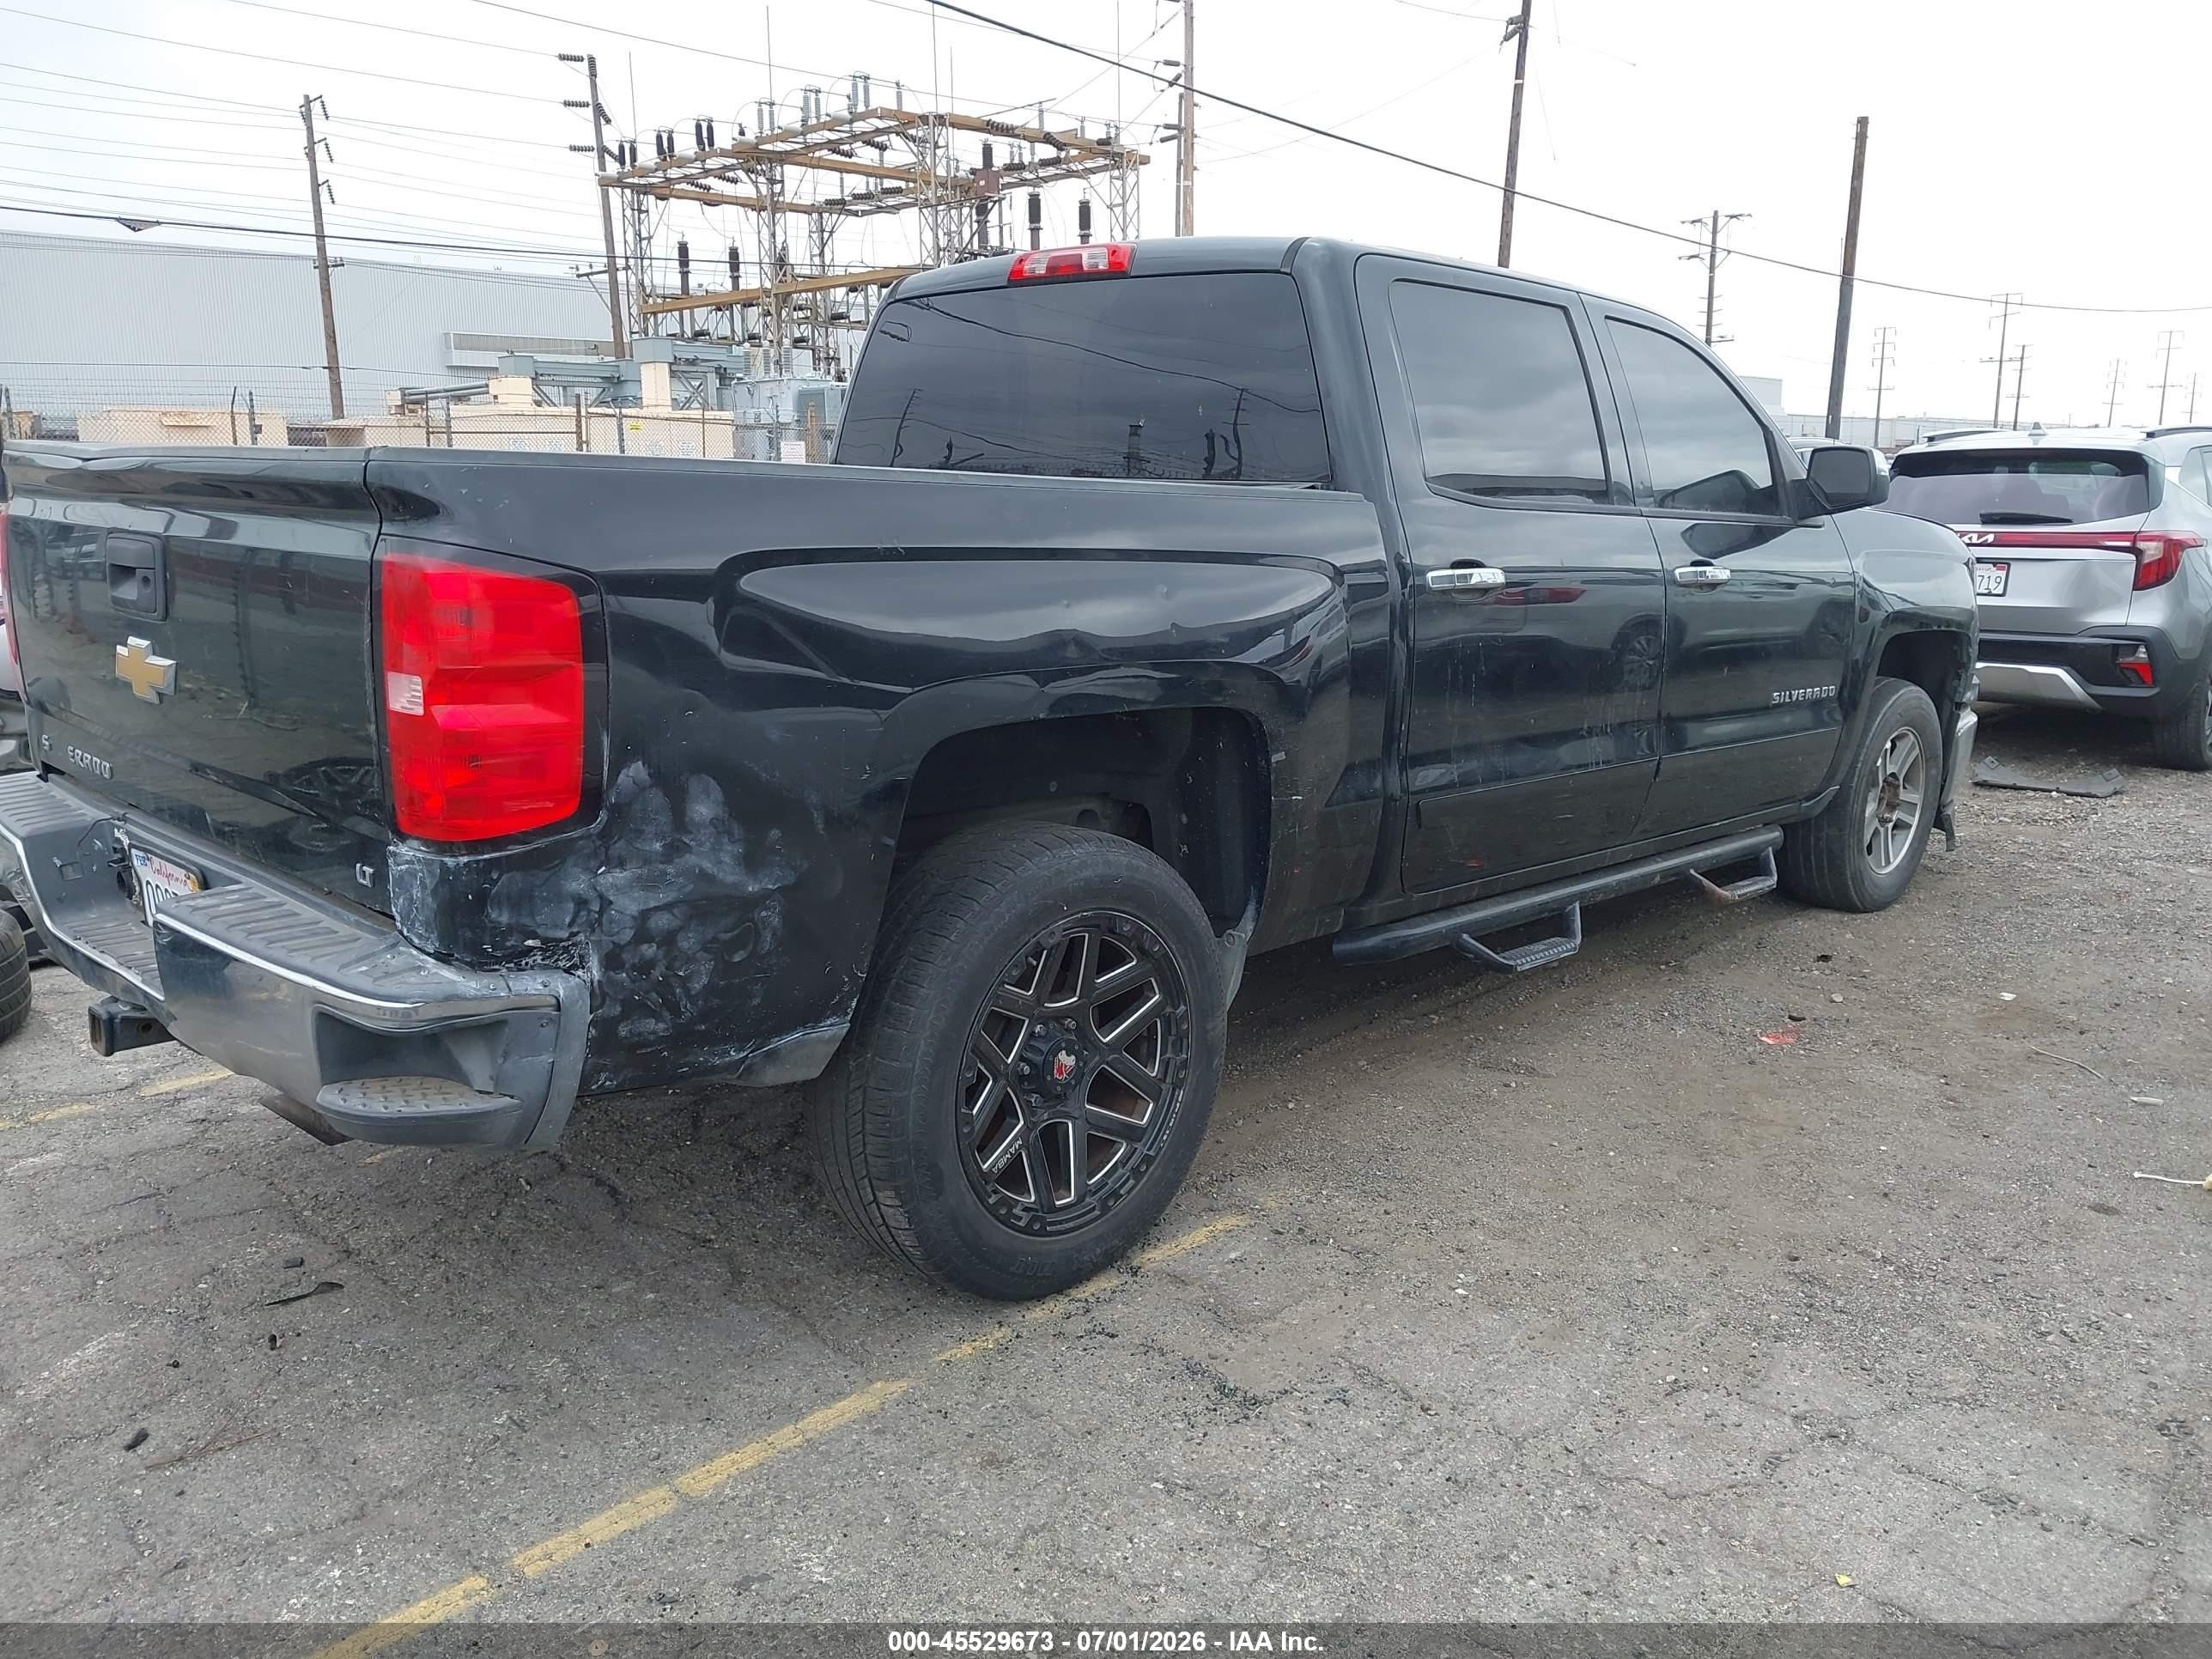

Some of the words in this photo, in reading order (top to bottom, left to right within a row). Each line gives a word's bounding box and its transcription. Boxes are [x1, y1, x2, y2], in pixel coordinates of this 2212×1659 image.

[1977, 574, 2002, 592] 719
[1771, 685, 1836, 704] SILVERADO
[149, 856, 189, 887] California
[356, 863, 374, 888] LT
[991, 1137, 1023, 1174] MAMBA
